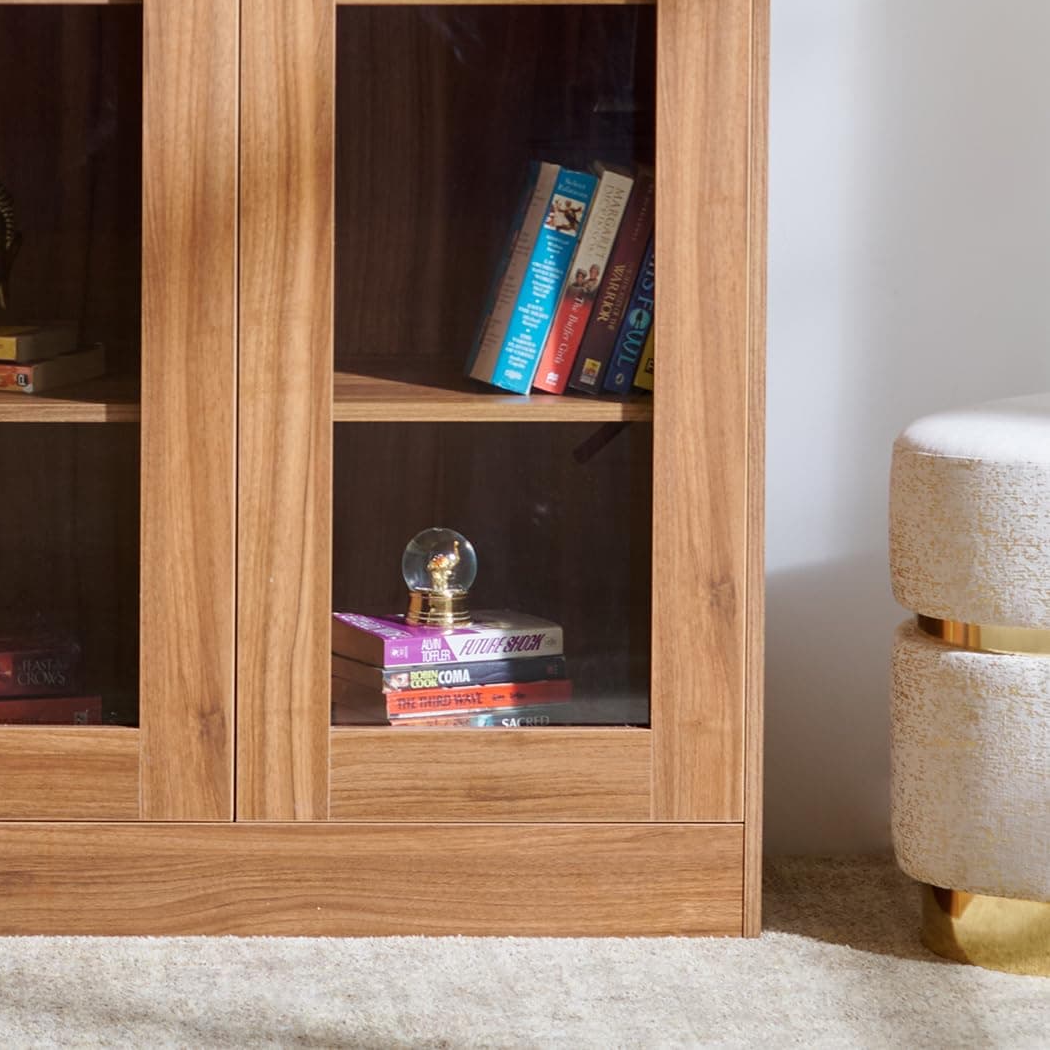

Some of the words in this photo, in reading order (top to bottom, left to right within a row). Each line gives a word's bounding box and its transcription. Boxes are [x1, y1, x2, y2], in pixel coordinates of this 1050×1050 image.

[598, 187, 626, 259] MARGARET
[597, 264, 626, 322] WARRIOR
[573, 297, 585, 312] The
[560, 313, 579, 341] Buffer
[421, 638, 442, 651] ALVIN
[458, 636, 504, 656] FUTURE
[503, 634, 547, 653] SHOCK
[421, 649, 451, 663] TOFFLER
[16, 670, 67, 686] CROWS
[409, 678, 438, 688] COOK
[438, 669, 471, 684] COMA
[396, 696, 418, 710] THE
[419, 694, 453, 708] THIRD
[453, 692, 484, 706] WAVE
[501, 715, 550, 727] SACRED
